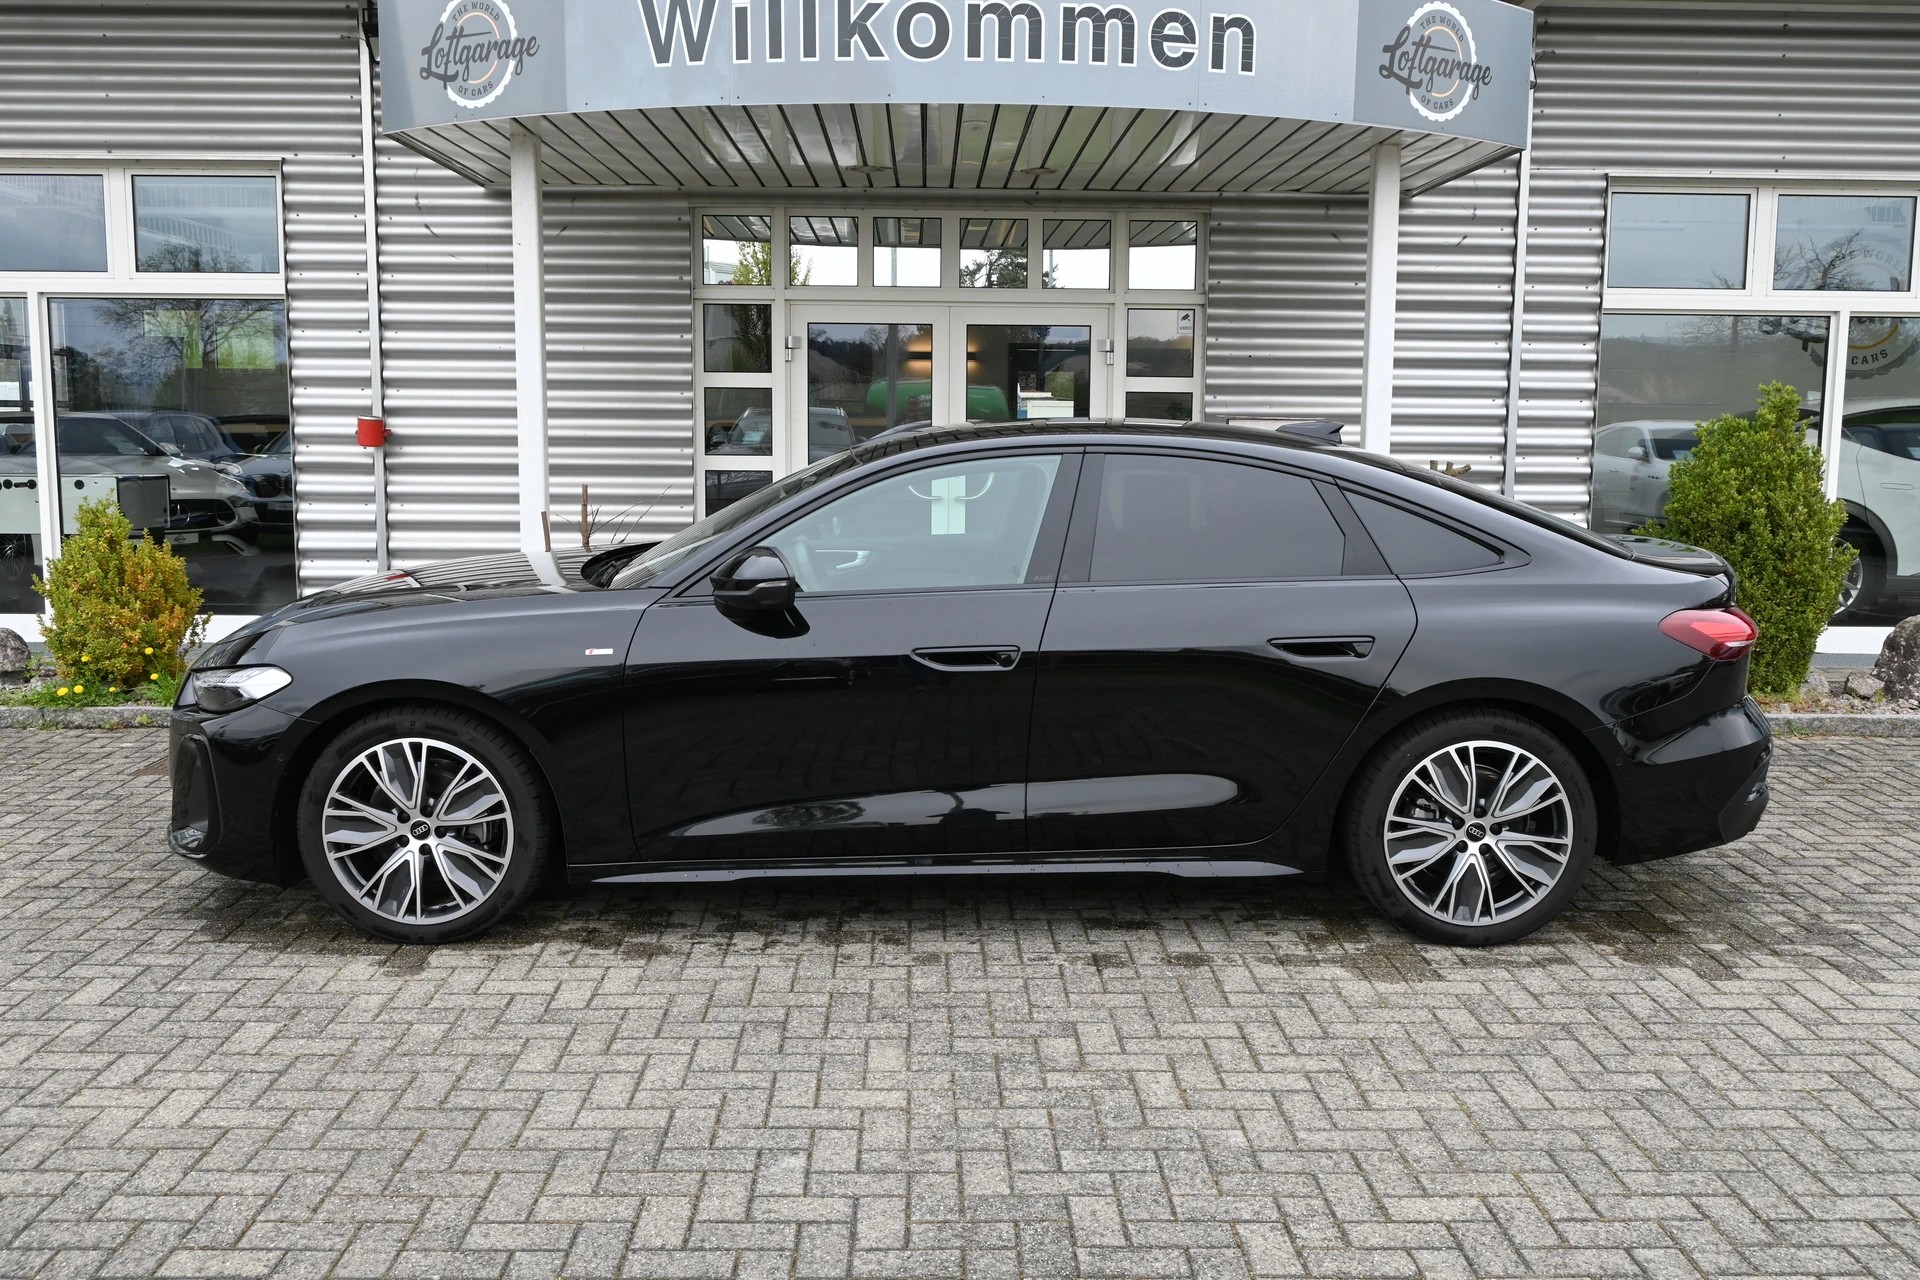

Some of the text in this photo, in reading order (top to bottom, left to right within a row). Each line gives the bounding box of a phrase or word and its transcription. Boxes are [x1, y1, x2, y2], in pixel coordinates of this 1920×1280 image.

[452, 1, 500, 22] THE WORLD
[638, 0, 1257, 76] Willkommen
[1420, 16, 1464, 42] THE WORLD
[419, 22, 540, 91] Loftgarage
[1379, 26, 1493, 100] Loftgarage
[458, 81, 494, 97] OF CARS
[1421, 95, 1454, 110] OF CARS
[1851, 349, 1889, 365] CARS
